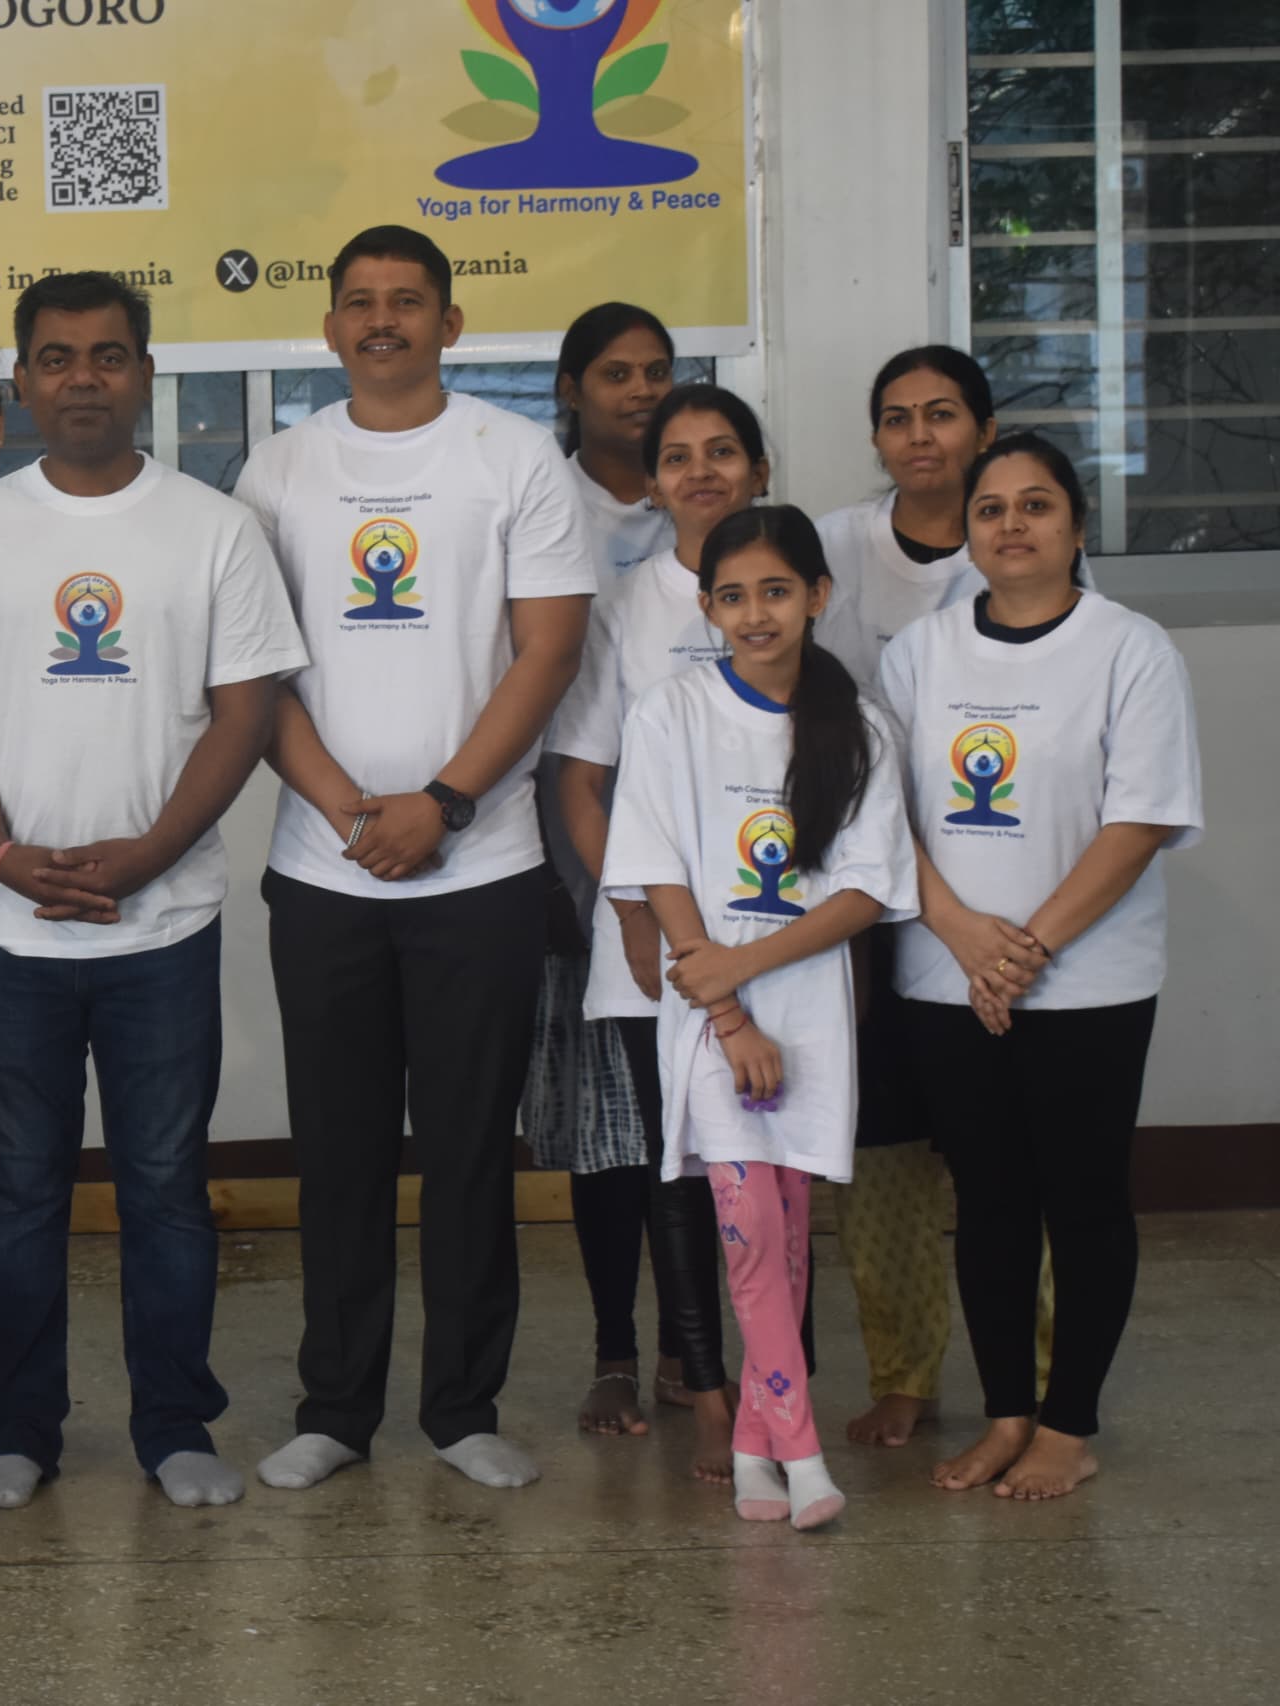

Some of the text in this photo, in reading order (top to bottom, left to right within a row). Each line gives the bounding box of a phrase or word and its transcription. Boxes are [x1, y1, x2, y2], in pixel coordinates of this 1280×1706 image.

[416, 189, 720, 220] Yoga for Harmony & Peace
[7, 265, 35, 290] in
[42, 261, 174, 288] Tania
